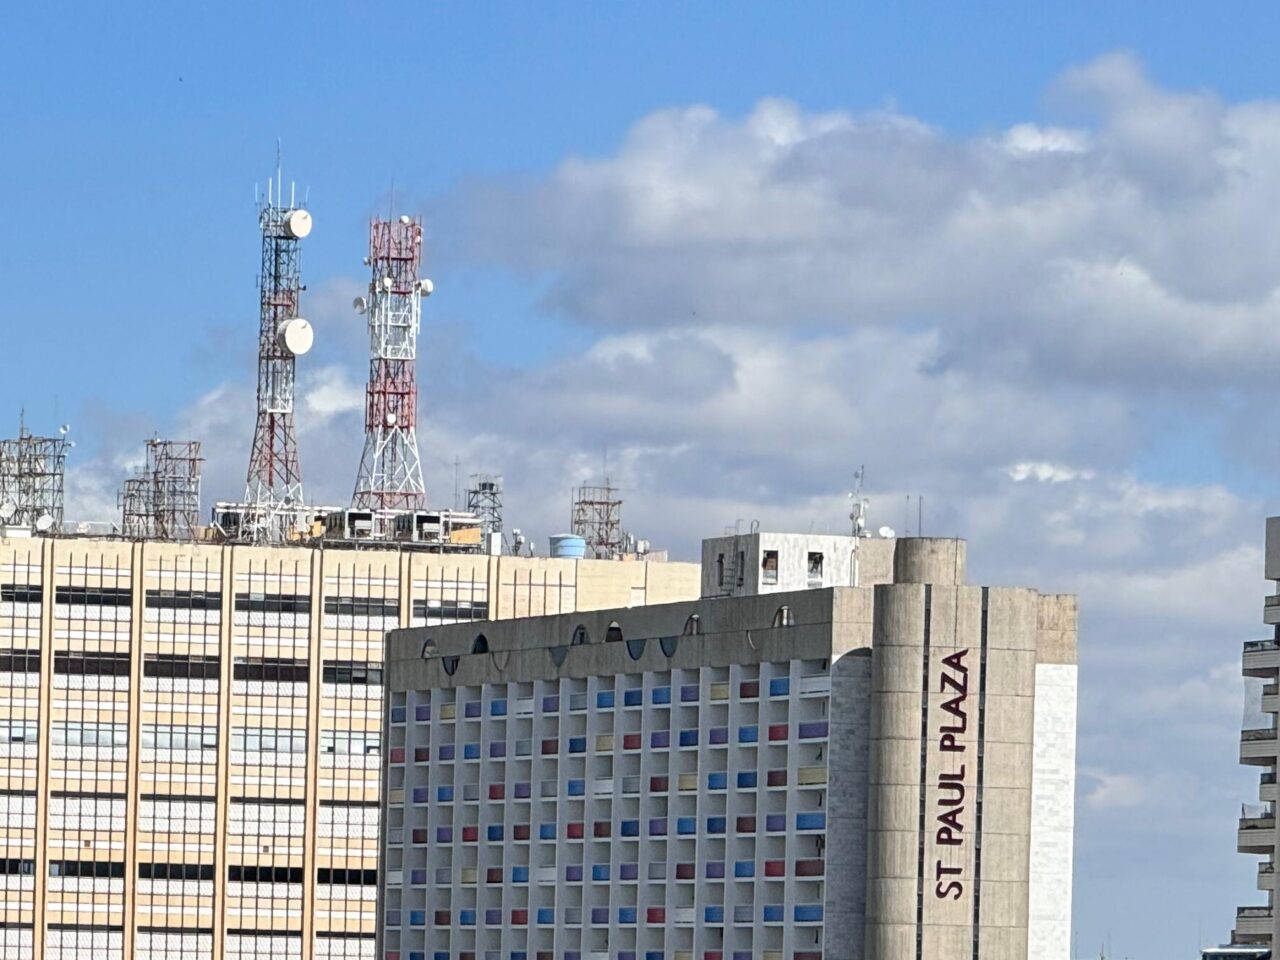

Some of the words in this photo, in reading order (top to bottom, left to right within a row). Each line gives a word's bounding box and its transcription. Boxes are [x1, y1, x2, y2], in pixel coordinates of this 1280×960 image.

[939, 648, 969, 751] PLAZA
[936, 764, 965, 845] PAUL
[935, 860, 963, 900] ST
